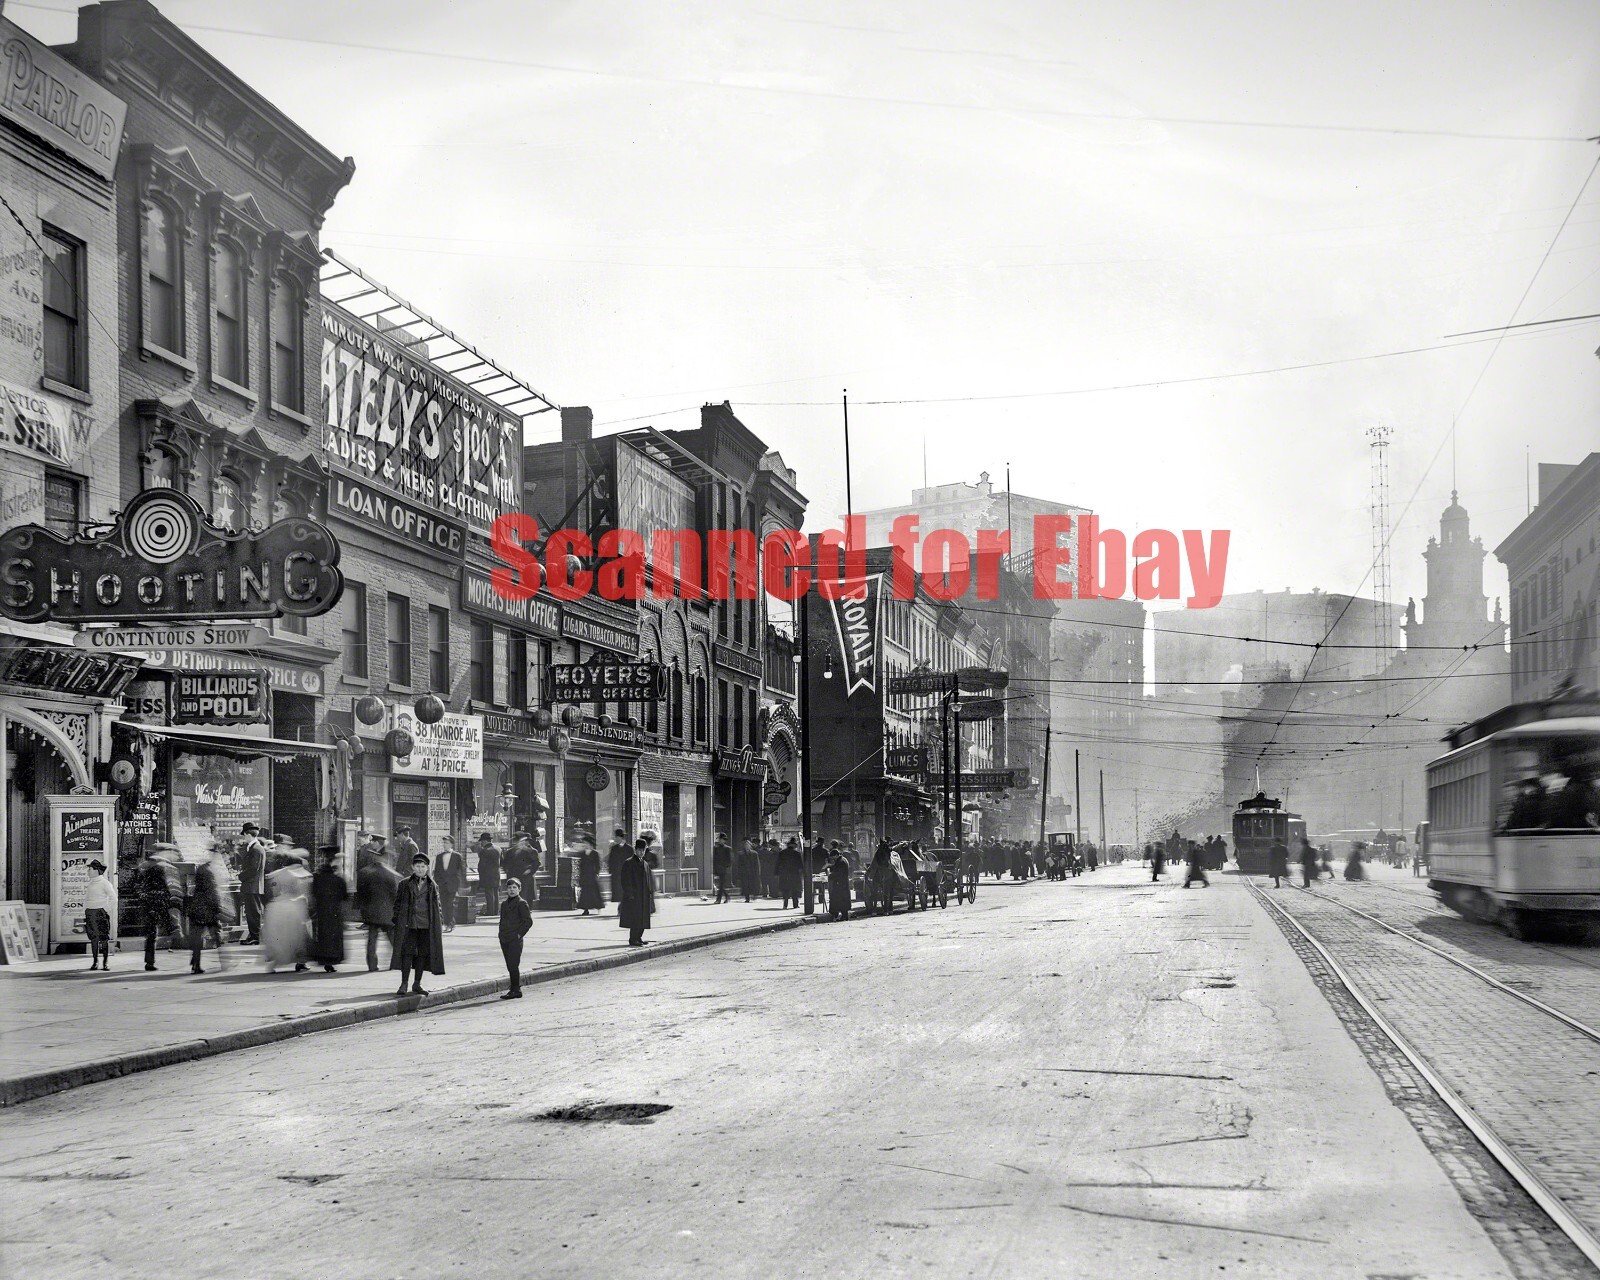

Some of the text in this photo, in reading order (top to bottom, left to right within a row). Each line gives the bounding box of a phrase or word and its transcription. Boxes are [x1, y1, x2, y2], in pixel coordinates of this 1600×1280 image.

[3, 37, 117, 161] PARLOR
[322, 311, 370, 354] MINUTE
[372, 342, 405, 376] WALK
[410, 367, 427, 388] ON
[433, 377, 482, 420] MICHIGAN
[383, 458, 396, 480] &
[337, 480, 461, 553] LOAN OFFICE
[3, 551, 319, 607] SHOOTING
[468, 576, 504, 612] MOYER'S
[505, 590, 528, 620] LOAN
[91, 628, 250, 647] CONTINUOUS SHOW
[841, 583, 874, 673] ROYALE
[172, 651, 222, 670] DETROIT
[555, 665, 651, 685] MOYER'S
[182, 677, 258, 695] BILLIARDS
[556, 687, 652, 700] LOAN OFFICE
[125, 698, 163, 714] EISS
[180, 697, 261, 716] AND POOL
[415, 721, 427, 738] 38
[430, 723, 463, 742] MONROE
[465, 728, 480, 743] AVE.
[487, 714, 516, 733] MOYER'S
[421, 759, 430, 771] AT
[441, 759, 469, 773] PRICE.
[64, 815, 101, 837] ALHAMBRA
[134, 827, 154, 835] SALE
[66, 835, 99, 845] ADMISSION
[61, 857, 88, 871] OPEN
